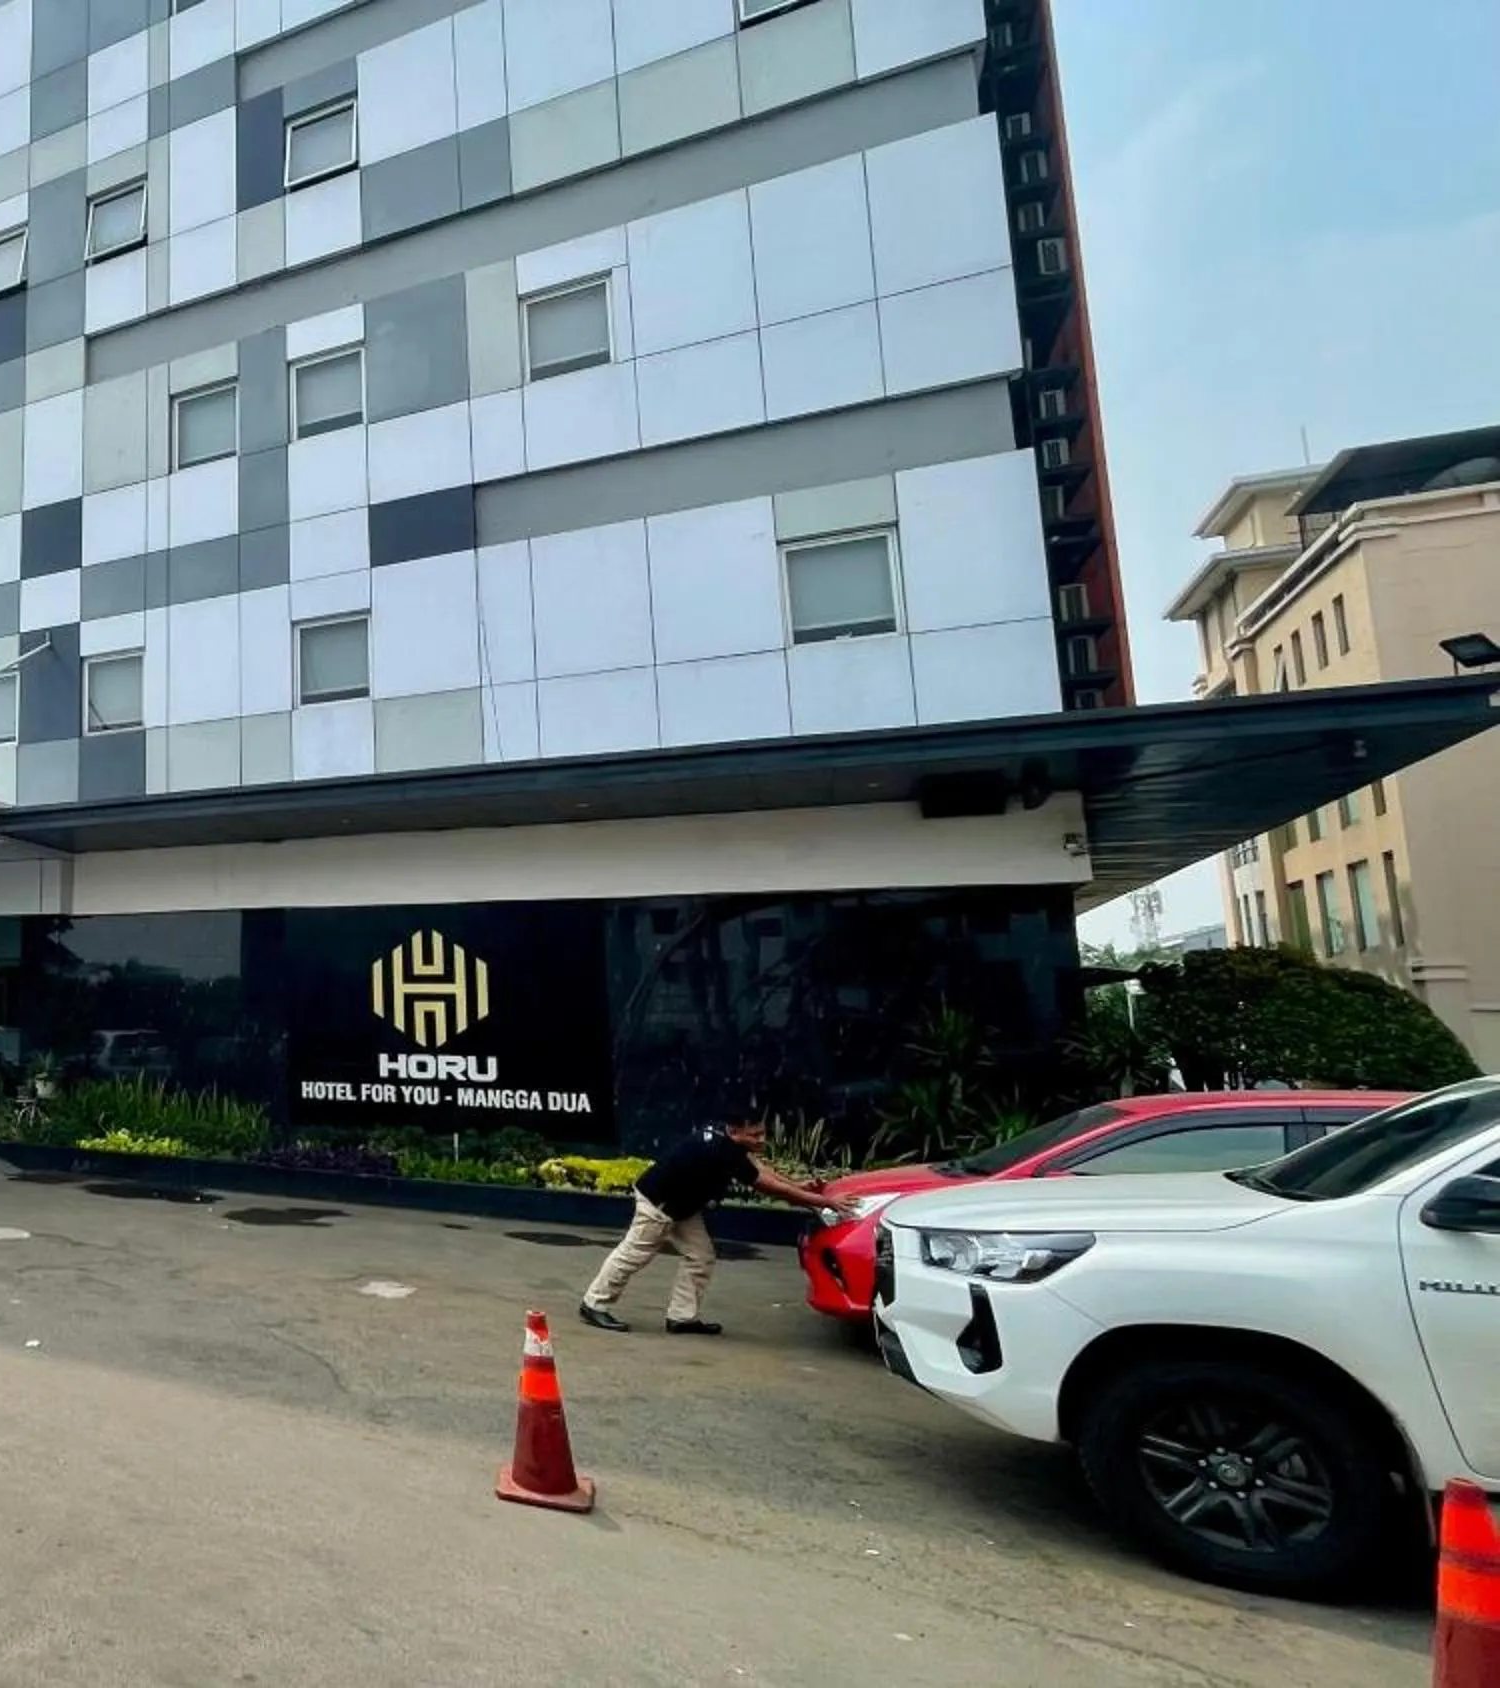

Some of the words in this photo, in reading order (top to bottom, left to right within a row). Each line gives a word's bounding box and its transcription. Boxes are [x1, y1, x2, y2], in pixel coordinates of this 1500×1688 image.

[378, 1053, 498, 1083] HORU
[301, 1081, 357, 1101] HOTEL
[360, 1083, 397, 1103] FOR
[399, 1085, 440, 1105] YOU
[457, 1087, 543, 1111] MANGGA
[547, 1091, 592, 1113] DUA
